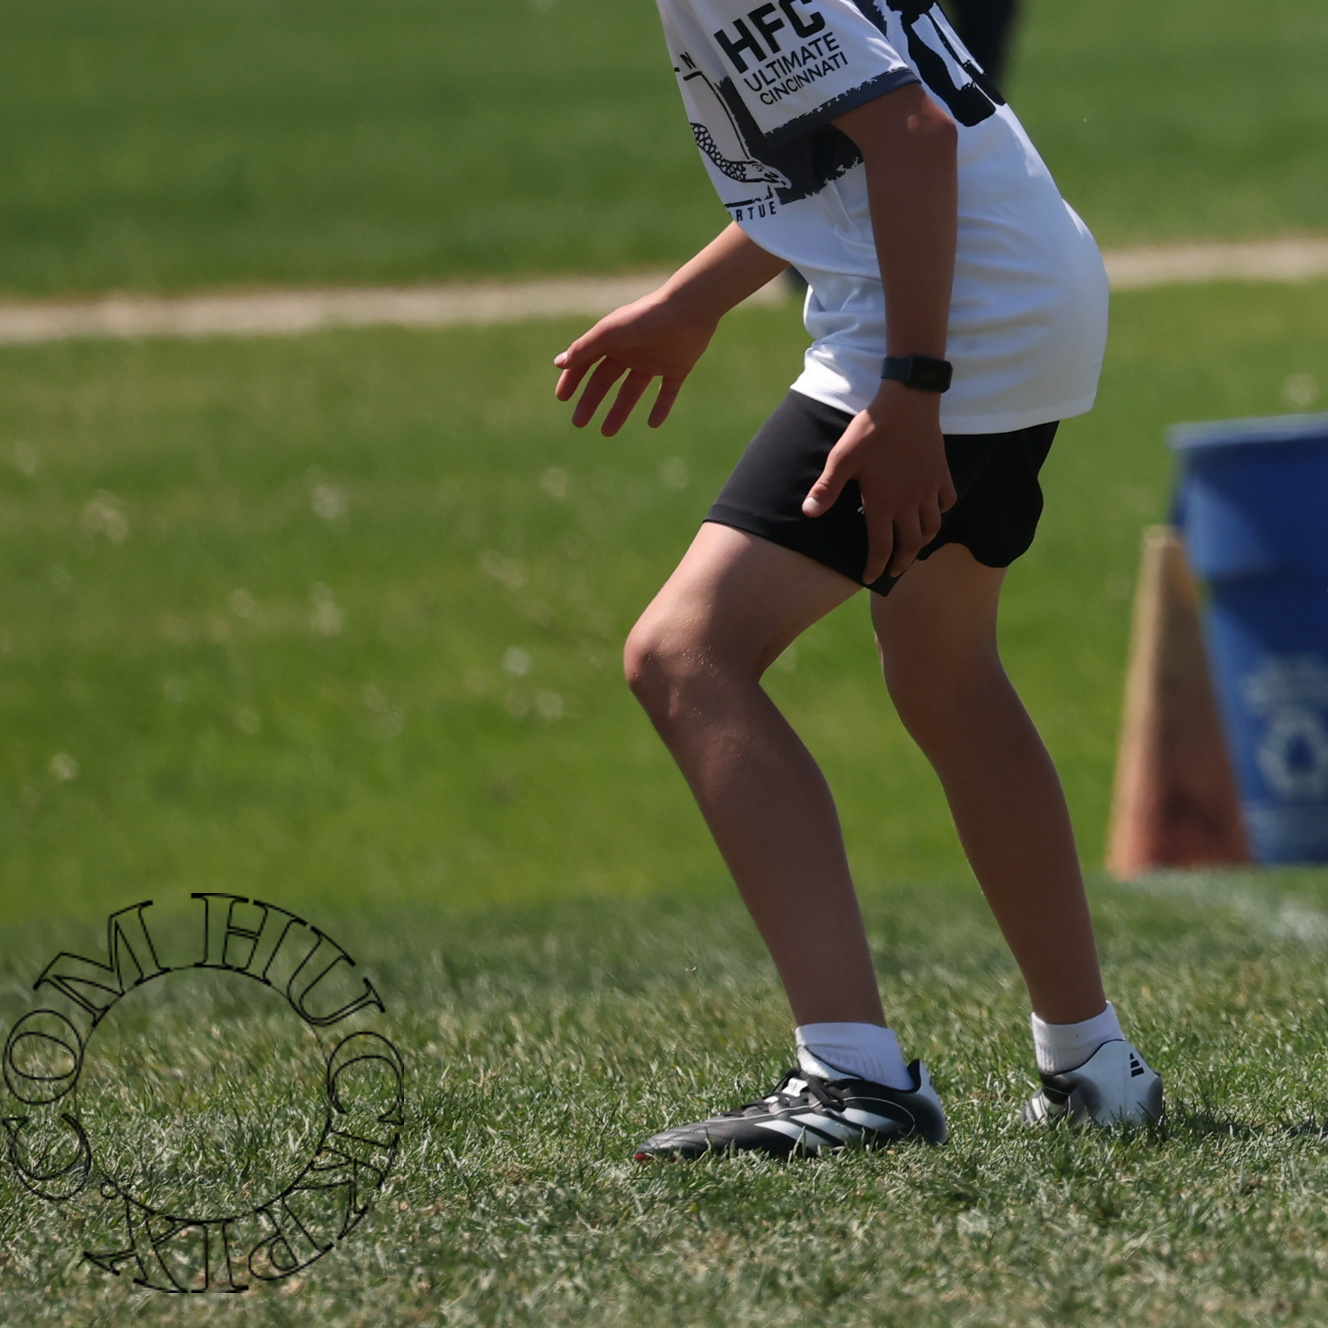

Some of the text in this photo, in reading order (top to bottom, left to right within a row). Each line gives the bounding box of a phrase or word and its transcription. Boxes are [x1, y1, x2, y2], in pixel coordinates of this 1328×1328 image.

[743, 32, 840, 91] ULTIMATE
[760, 51, 848, 105] CINCINNATI
[728, 201, 777, 222] RTUE
